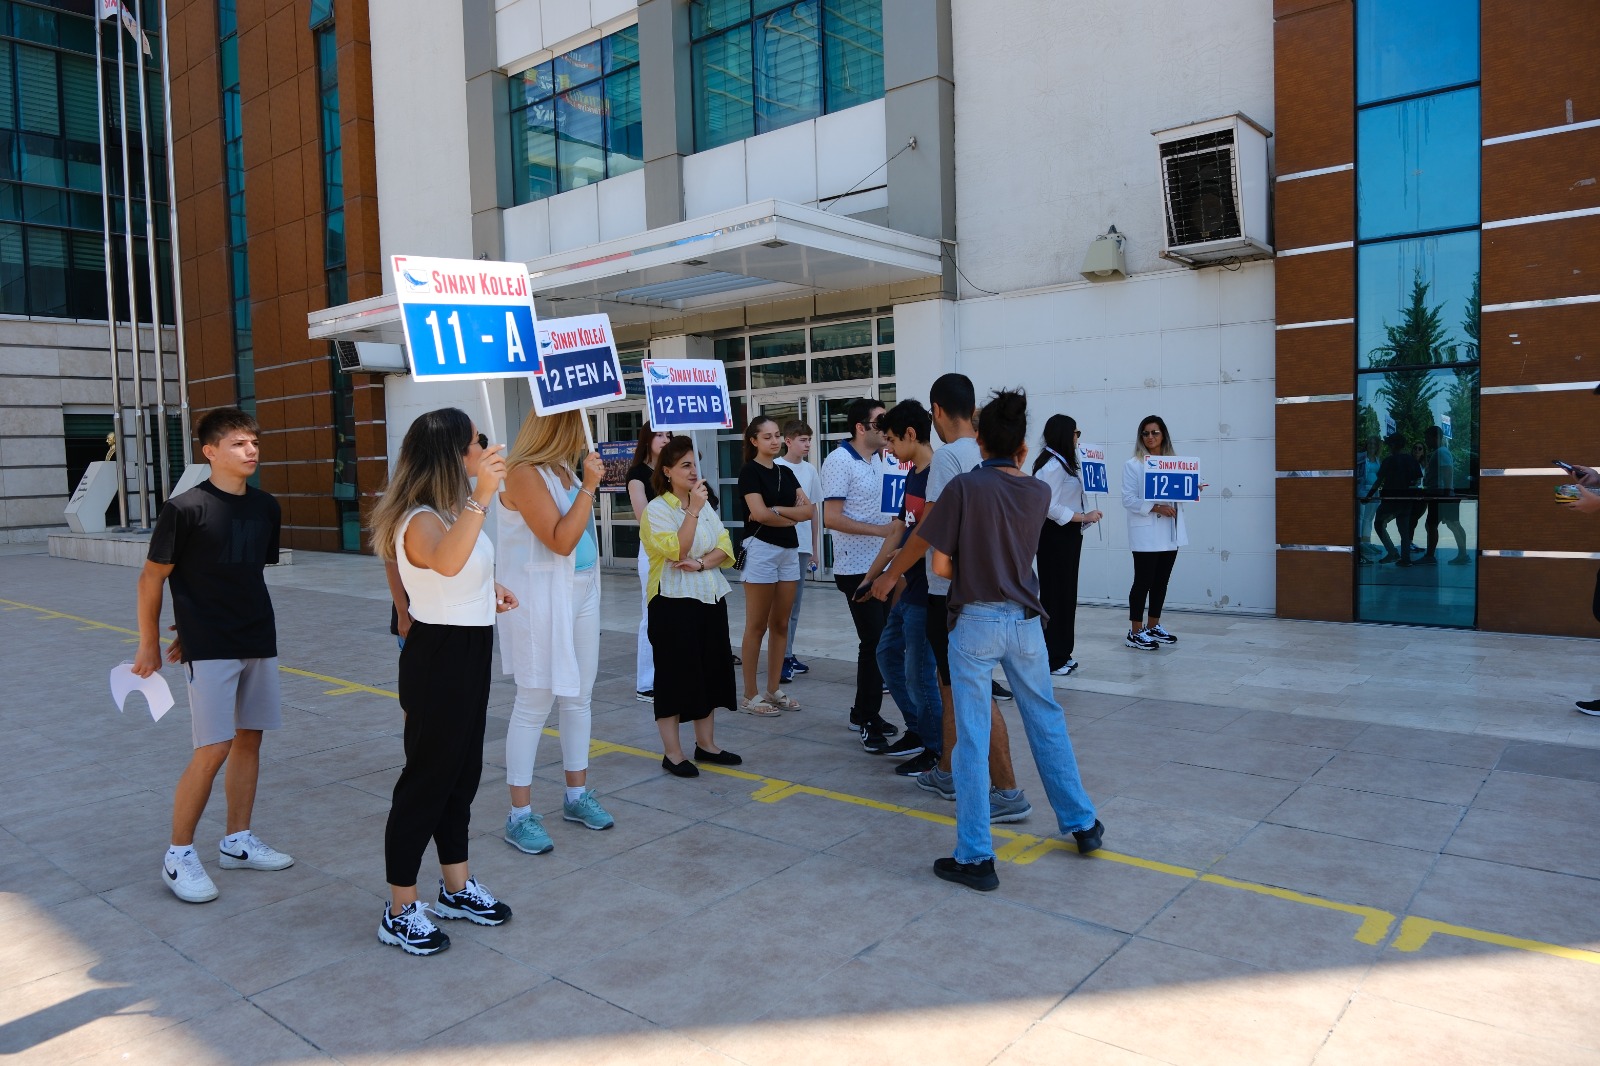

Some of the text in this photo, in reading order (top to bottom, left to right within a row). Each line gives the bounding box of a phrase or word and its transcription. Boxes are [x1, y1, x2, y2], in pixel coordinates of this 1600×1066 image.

[432, 270, 476, 295] SINAV
[425, 310, 527, 365] 11 - A
[551, 331, 578, 350] SINAV
[541, 369, 563, 393] 12
[564, 362, 600, 389] FEN
[603, 360, 615, 382] A
[669, 367, 691, 383] SINAV
[656, 395, 722, 414] 12 FEN B
[1085, 464, 1096, 488] 12
[1159, 460, 1177, 470] SINAV
[1152, 475, 1169, 496] 12
[1184, 475, 1193, 497] D
